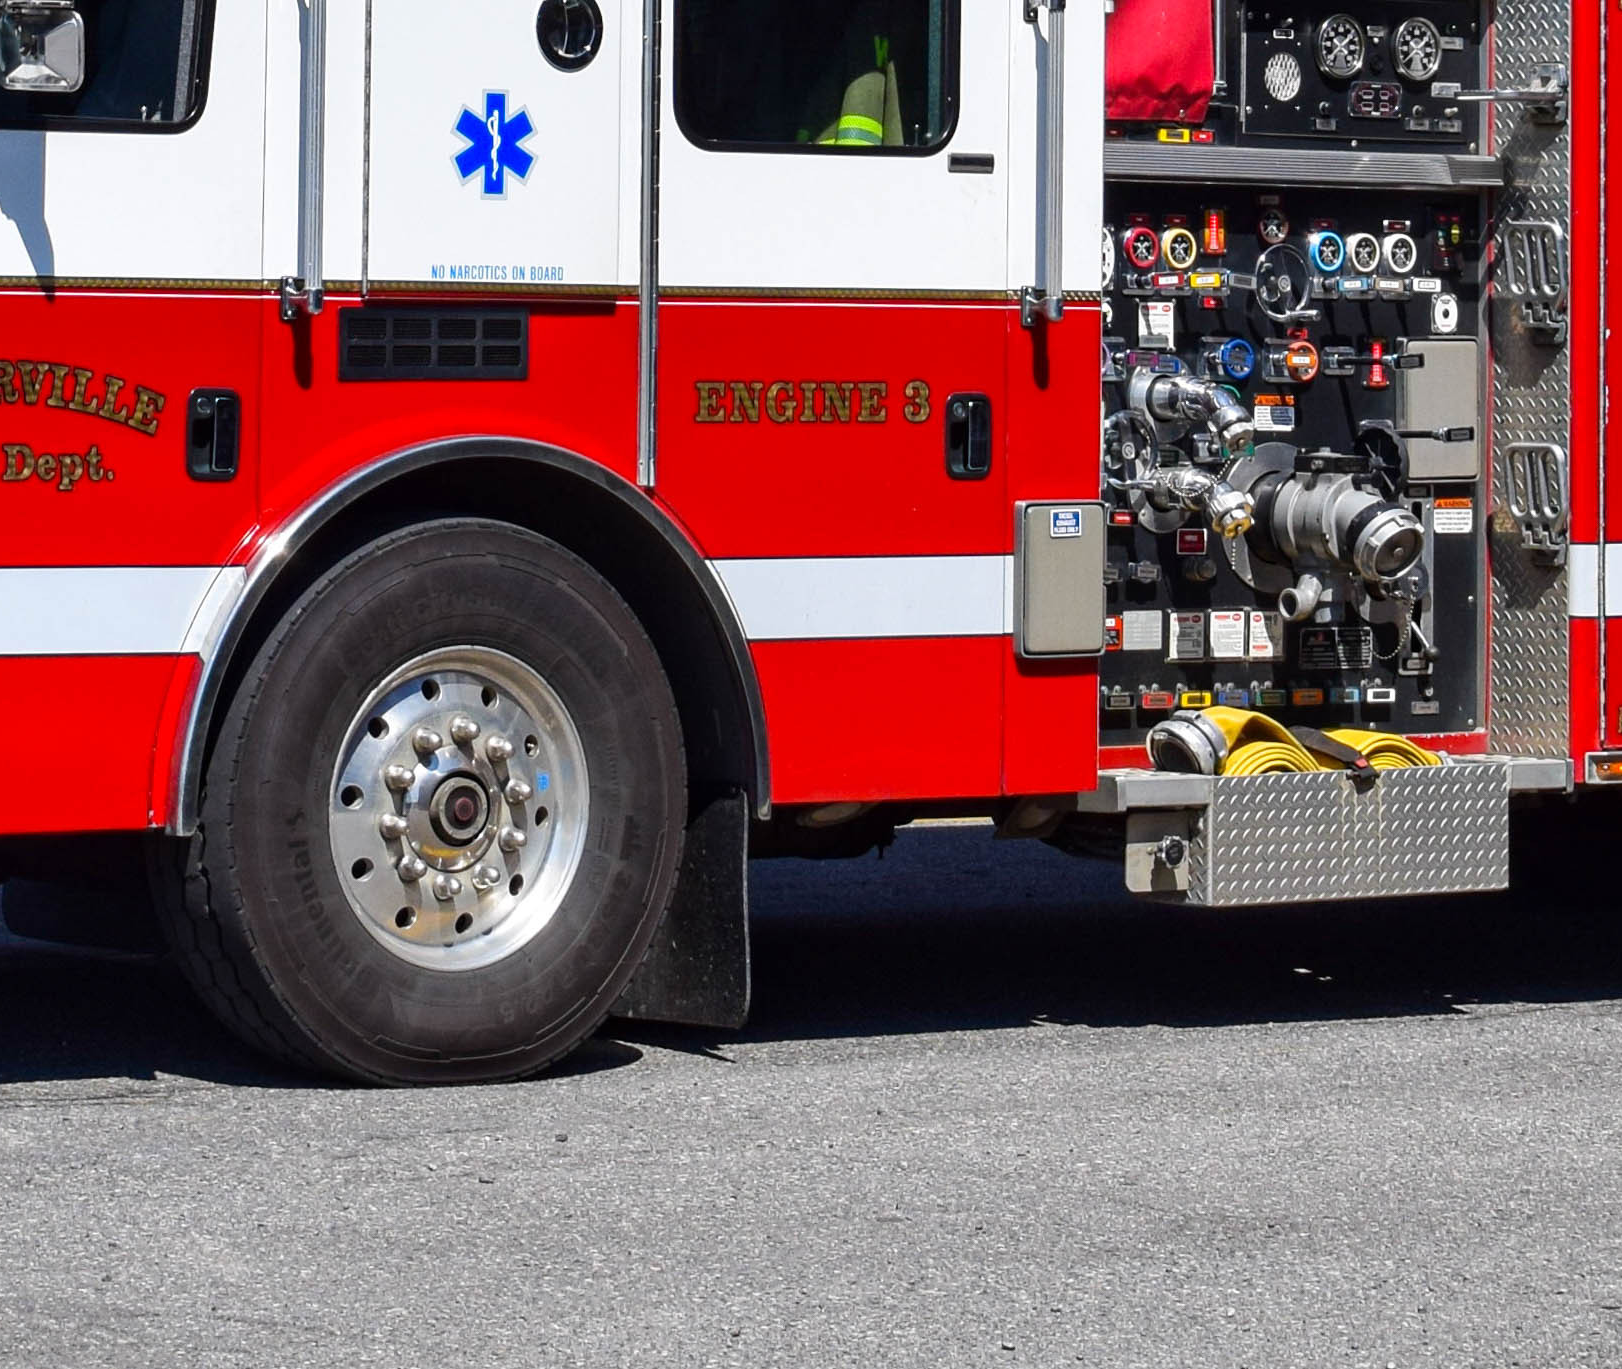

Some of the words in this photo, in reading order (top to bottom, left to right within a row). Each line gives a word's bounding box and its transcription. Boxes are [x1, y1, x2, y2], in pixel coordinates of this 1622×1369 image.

[431, 264, 445, 279] NO
[449, 264, 507, 280] NARCOTICS
[512, 265, 525, 280] ON
[530, 266, 564, 281] BOARD
[695, 381, 888, 423] ENGINE
[904, 380, 930, 423] 3
[2, 443, 115, 491] Dept.
